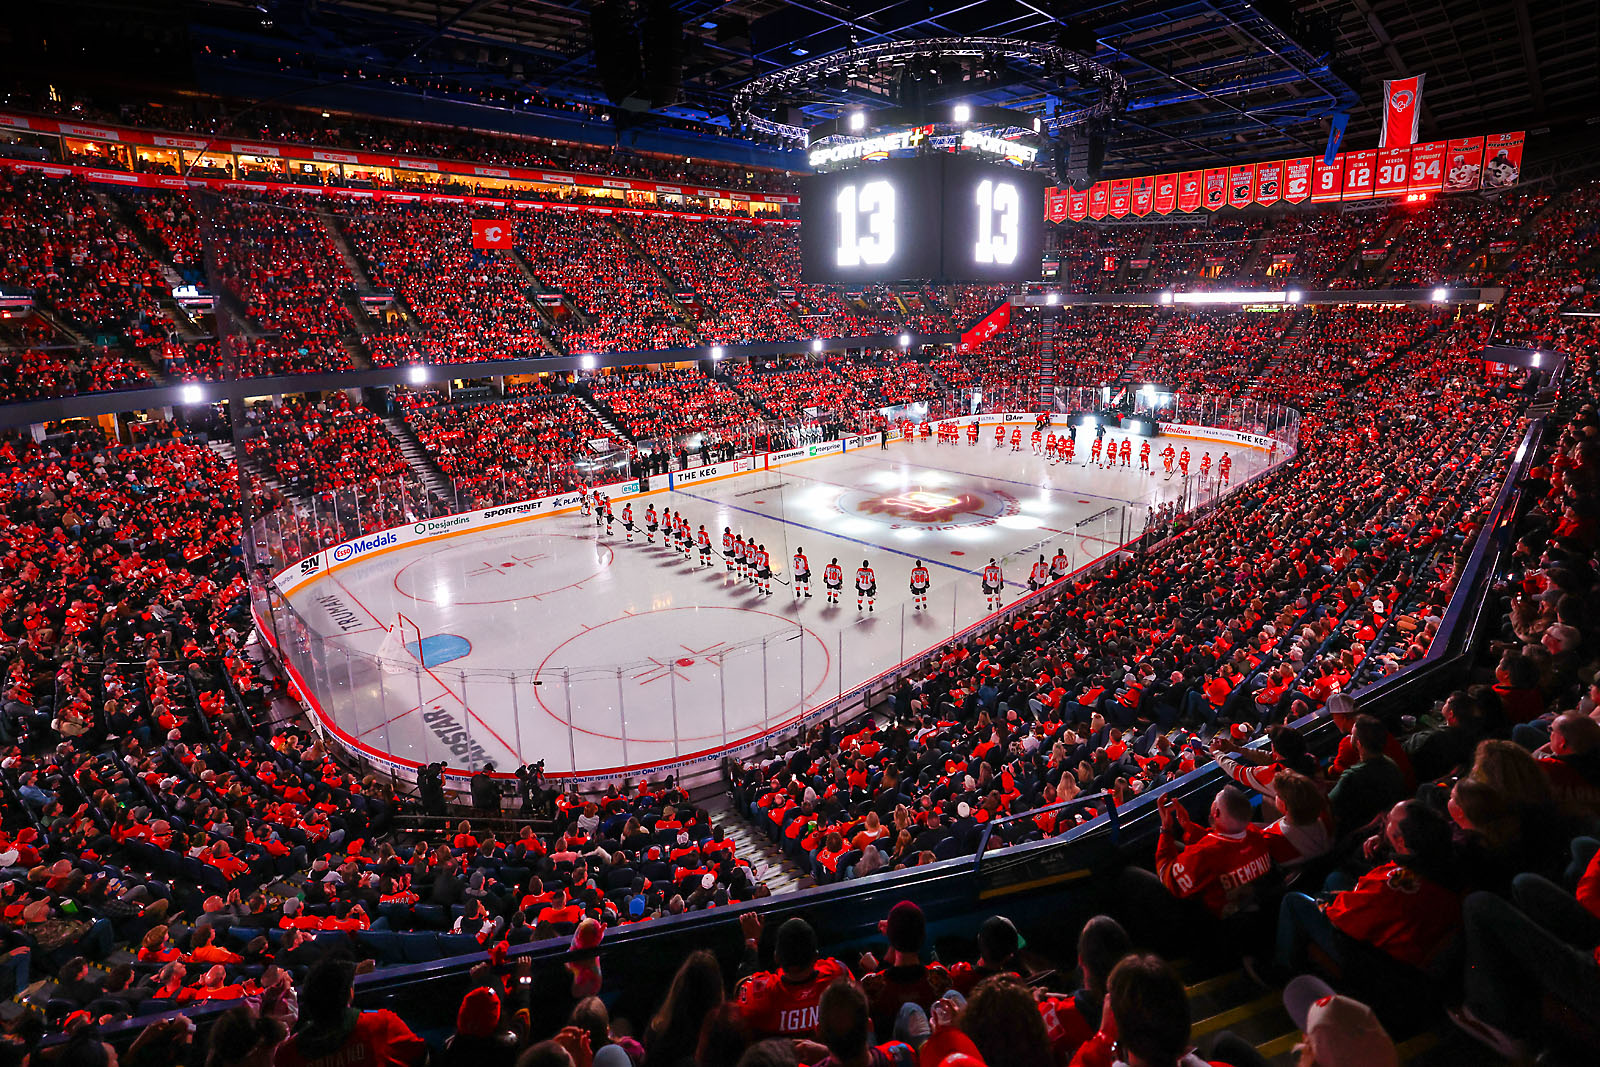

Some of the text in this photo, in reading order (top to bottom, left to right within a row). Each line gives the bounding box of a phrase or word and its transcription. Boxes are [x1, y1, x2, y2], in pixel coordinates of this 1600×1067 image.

[1348, 168, 1370, 187] 12
[1379, 164, 1406, 184] 30
[1412, 160, 1441, 180] 34
[1321, 172, 1334, 190] 9
[837, 181, 895, 266] 13
[975, 180, 1019, 265] 13
[1236, 433, 1252, 443] THE
[678, 468, 717, 482] THE KEG
[484, 501, 543, 519] SPORTSNET
[428, 516, 470, 531] Desjardins
[354, 532, 398, 554] Medals
[301, 555, 320, 573] SN
[829, 571, 837, 580] 10
[860, 575, 869, 584] 71
[316, 595, 362, 631] TRUMAN
[779, 1006, 820, 1032] IGIN
